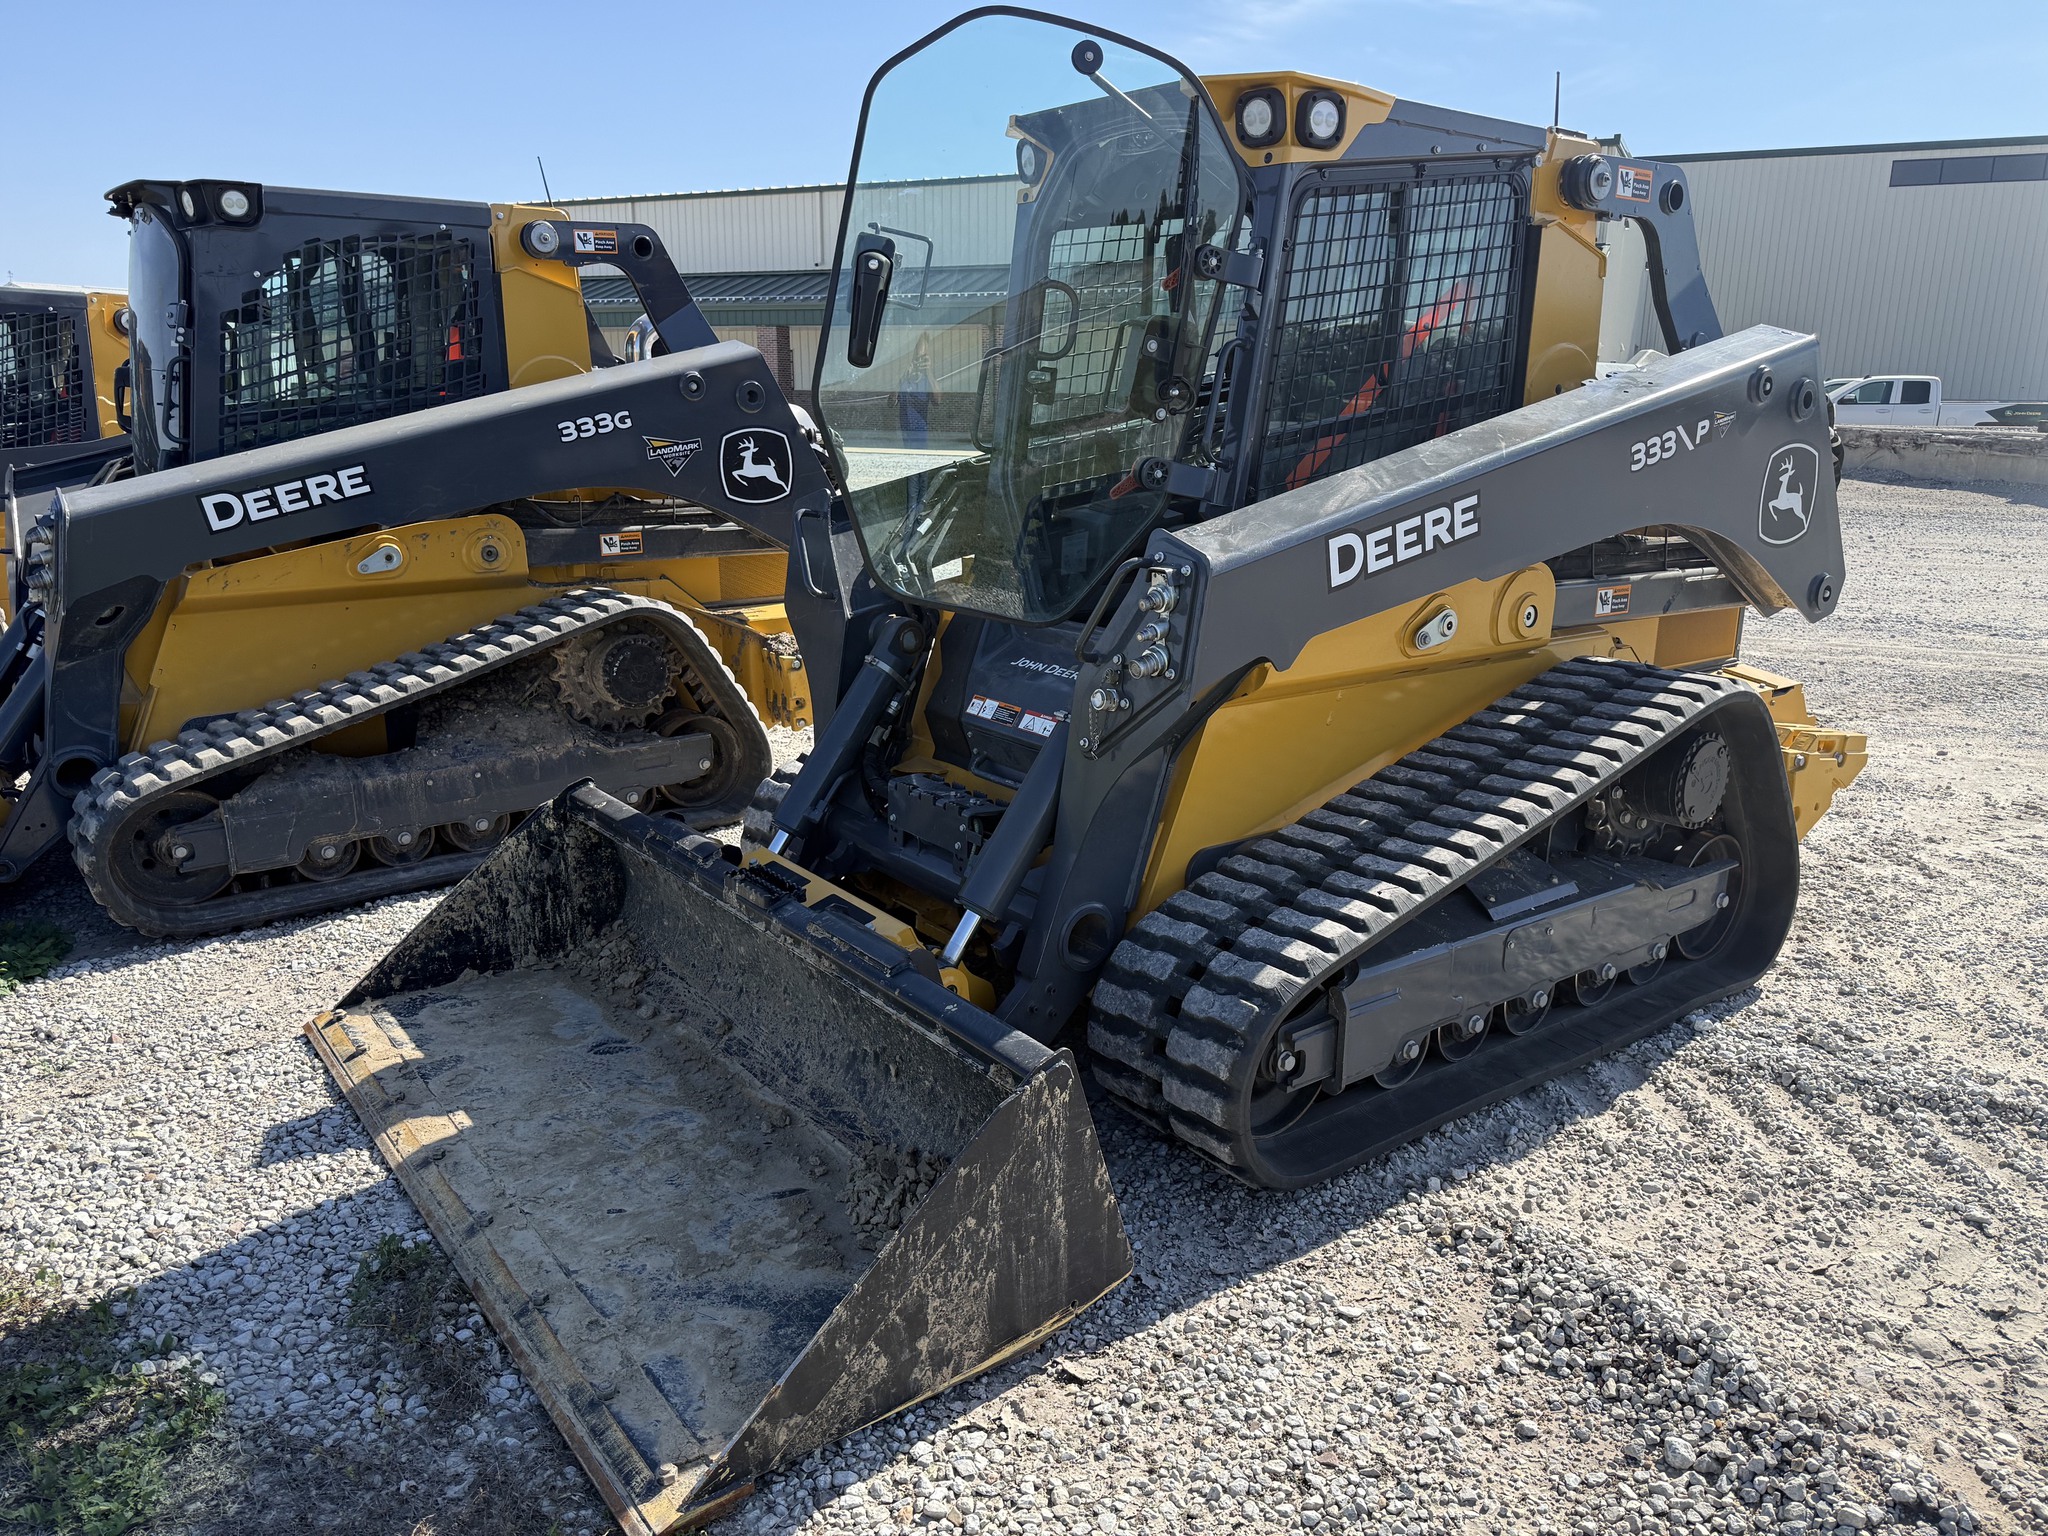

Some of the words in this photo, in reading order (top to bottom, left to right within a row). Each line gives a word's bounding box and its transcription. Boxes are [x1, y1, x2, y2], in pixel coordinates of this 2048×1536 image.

[558, 410, 632, 442] 333G
[662, 450, 691, 459] WORKSITE
[200, 465, 372, 532] DEERE
[1328, 494, 1479, 588] DEERE
[1010, 657, 1047, 673] JOHN
[1045, 664, 1080, 680] DEER
